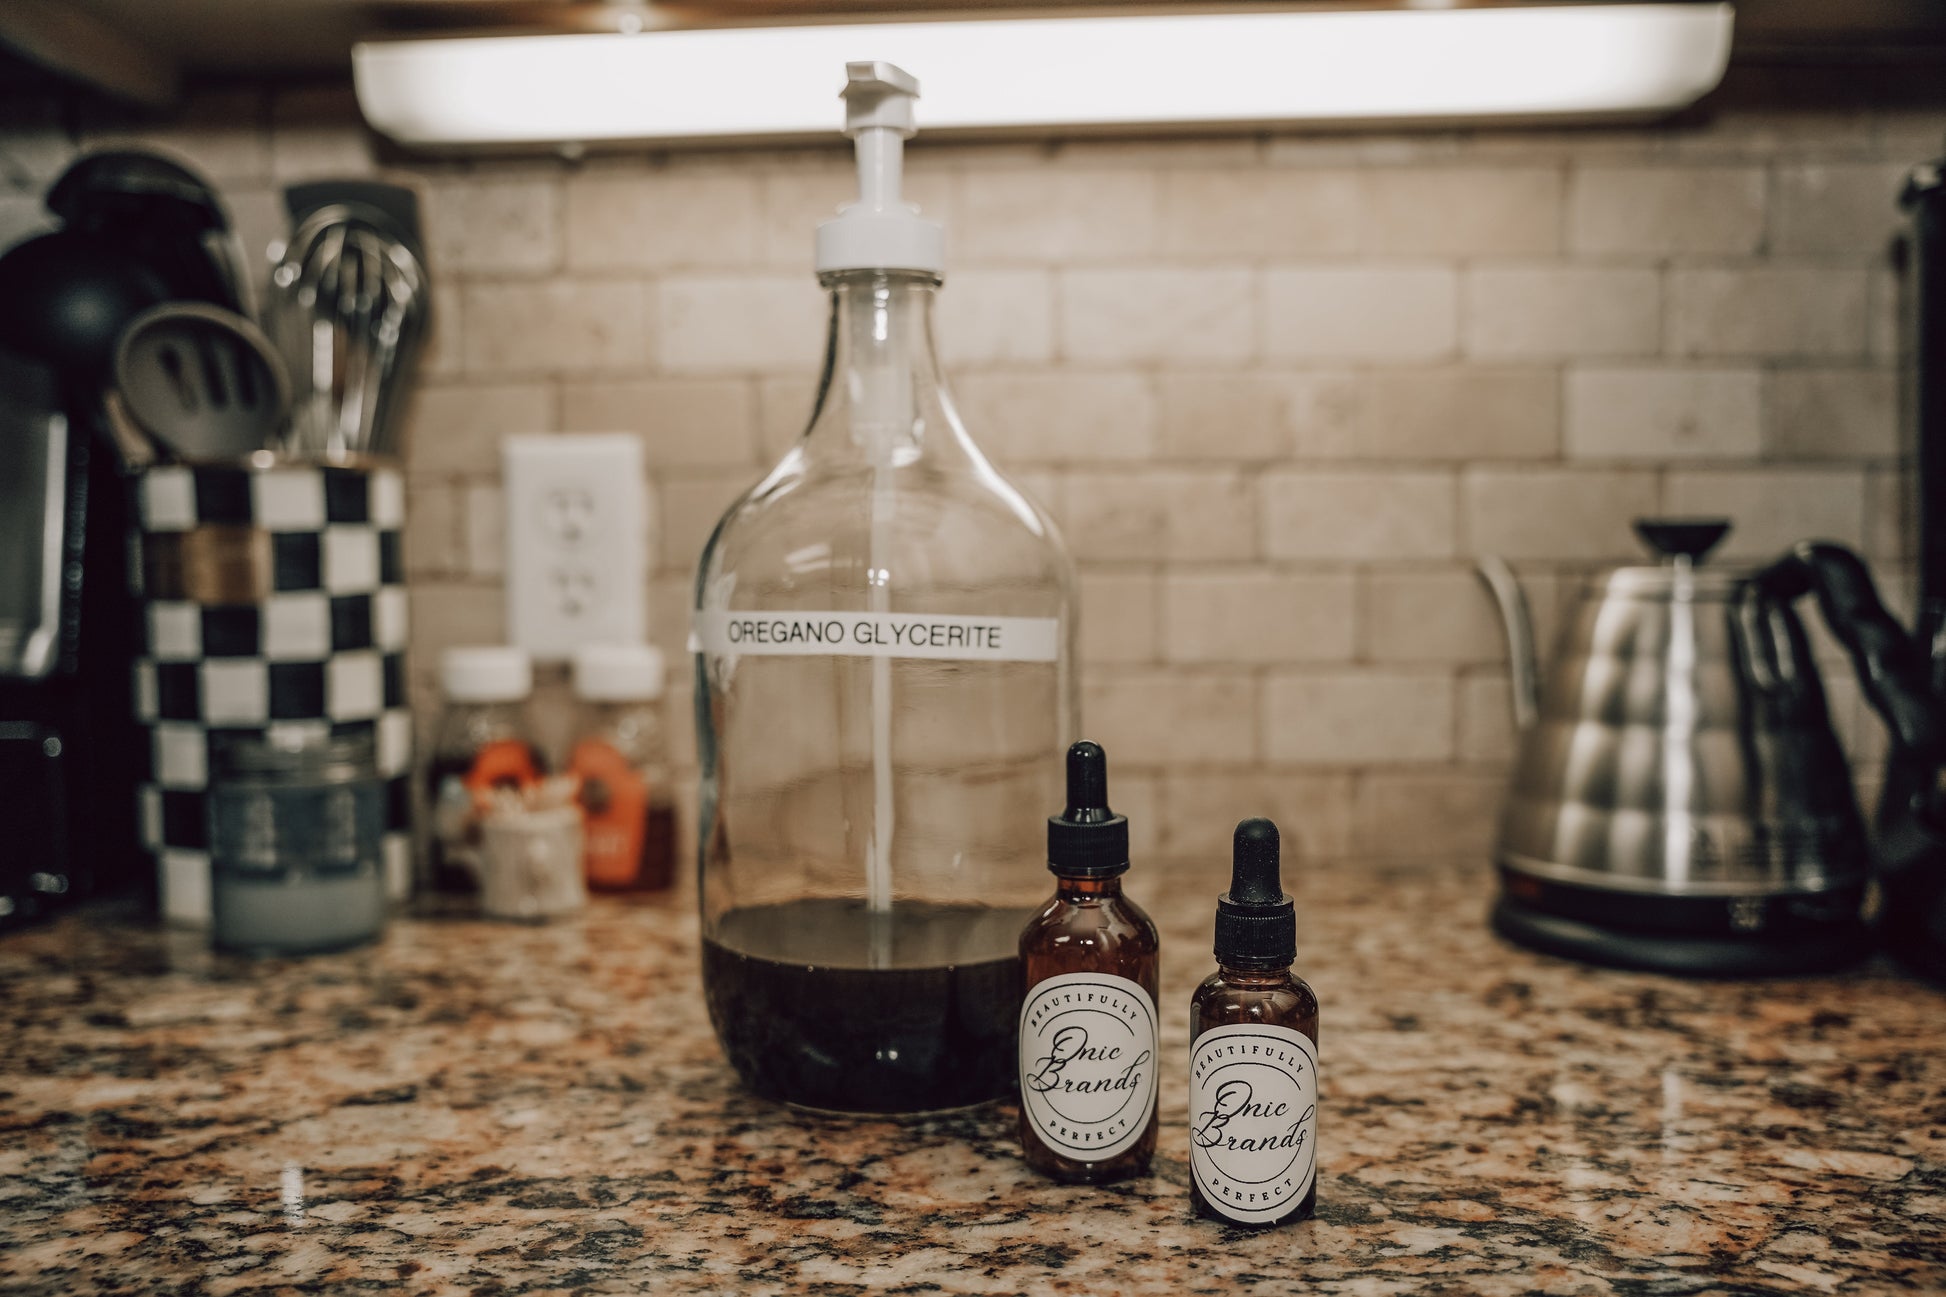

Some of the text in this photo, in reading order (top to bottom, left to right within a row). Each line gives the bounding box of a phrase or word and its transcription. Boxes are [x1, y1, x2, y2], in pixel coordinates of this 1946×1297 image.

[728, 620, 1003, 649] OREGANO GLYCERITE
[1030, 992, 1138, 1029] BEAUTIFULLY
[1026, 1050, 1150, 1094] Brands
[1195, 1045, 1304, 1079] BEAUTIFULLY
[1049, 1118, 1127, 1142] PERFECT
[1191, 1104, 1315, 1152] Brands
[1212, 1178, 1293, 1203] PERFECT
